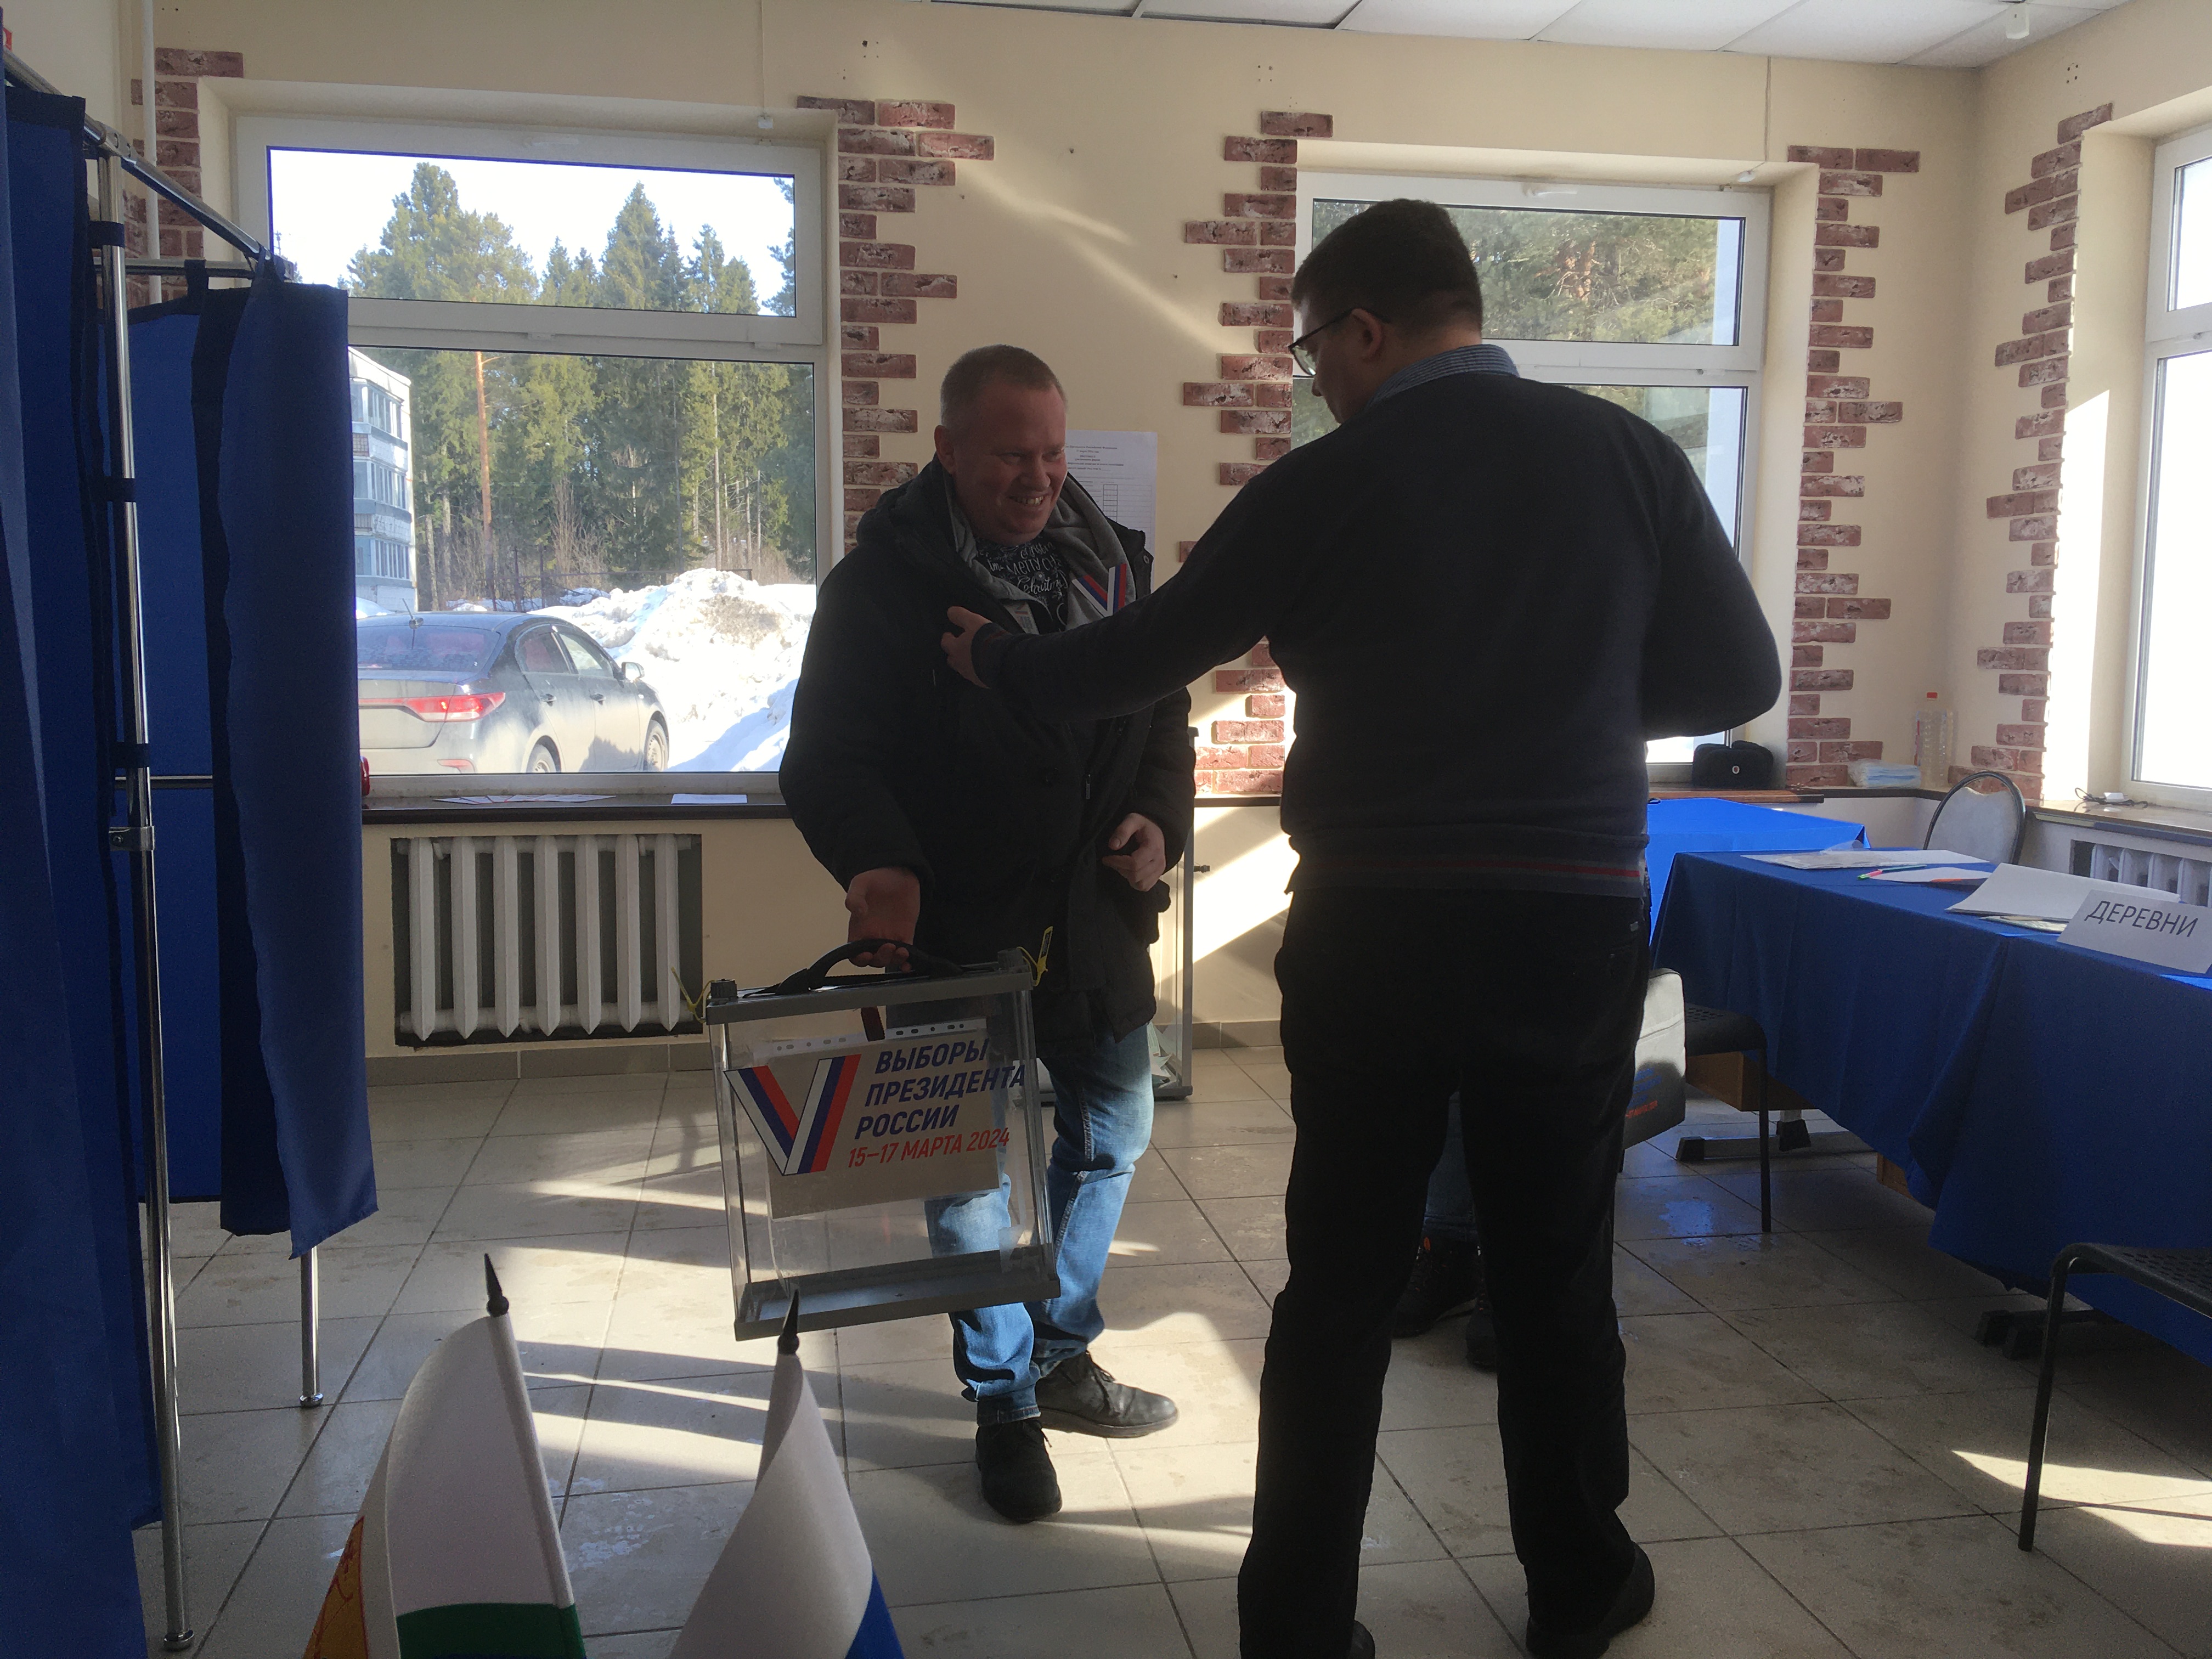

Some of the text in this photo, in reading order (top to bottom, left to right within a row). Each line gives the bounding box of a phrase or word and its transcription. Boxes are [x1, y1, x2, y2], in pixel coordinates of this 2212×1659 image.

[2084, 900, 2198, 937] ДЕРЕВНИ
[875, 1037, 990, 1074] ВЫБОРЫ
[864, 1064, 1026, 1107] ПРЕЗИДЕНТА
[854, 1104, 960, 1140] РОССИИ
[900, 1133, 963, 1161] МАРТА
[966, 1127, 1010, 1152] 2024
